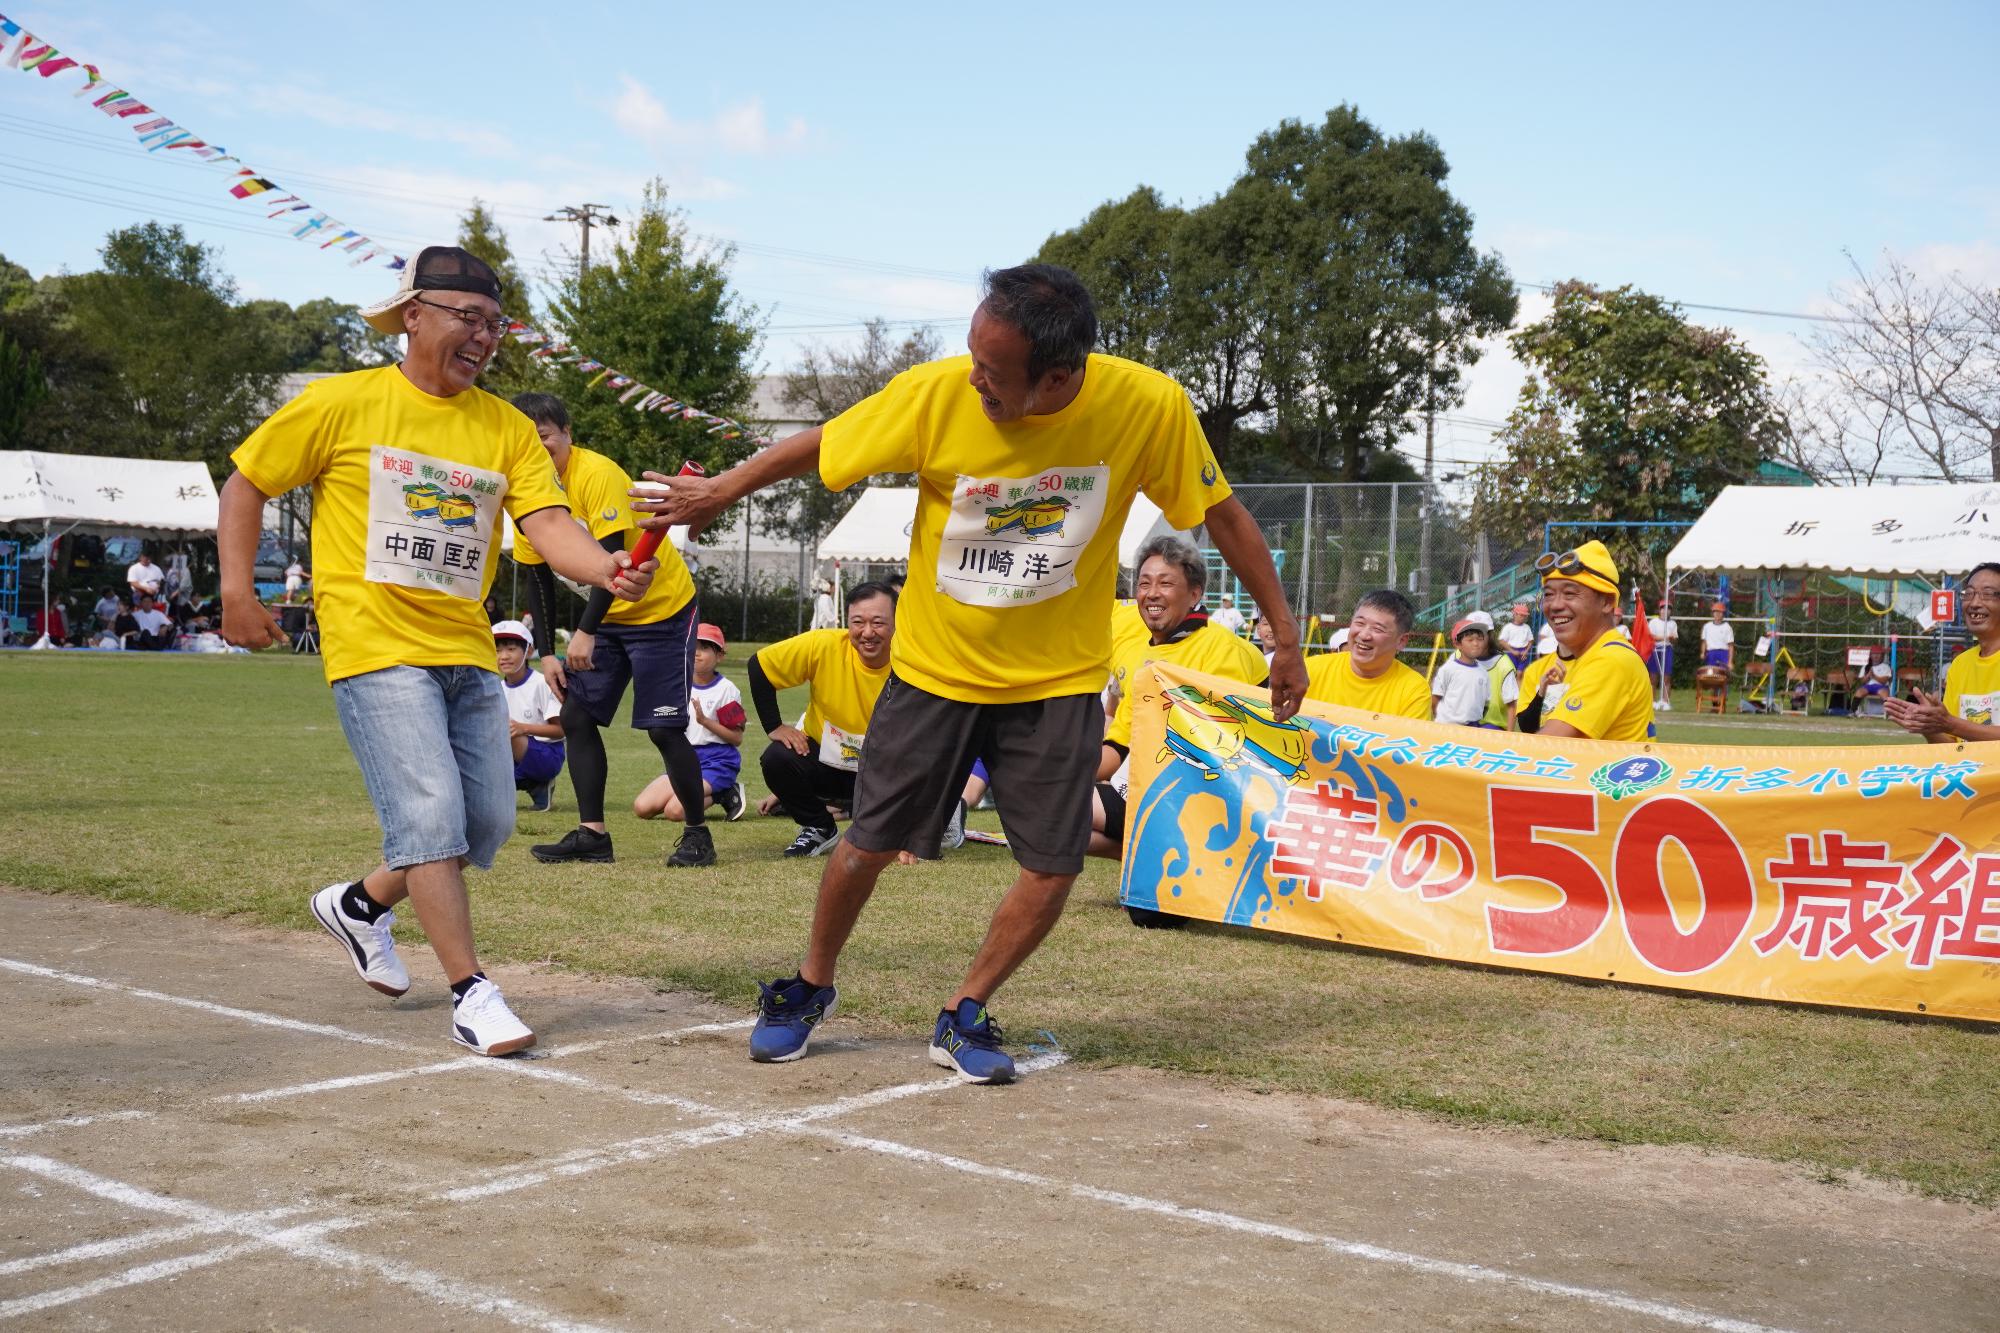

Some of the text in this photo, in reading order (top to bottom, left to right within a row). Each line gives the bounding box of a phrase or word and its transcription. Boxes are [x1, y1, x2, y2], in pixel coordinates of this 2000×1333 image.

[383, 455, 499, 496] 歓迎 華の50歳組
[966, 474, 1095, 500] 歓迎 華の50歳組
[385, 532, 481, 571] 中面 匡史
[959, 547, 1072, 580] 川崎 洋一
[416, 569, 454, 585] 阿久根市
[987, 586, 1037, 599] 阿久根市
[1329, 725, 1982, 799] 阿久根市立 折多小学校
[1265, 781, 2000, 973] 華の50歳組
